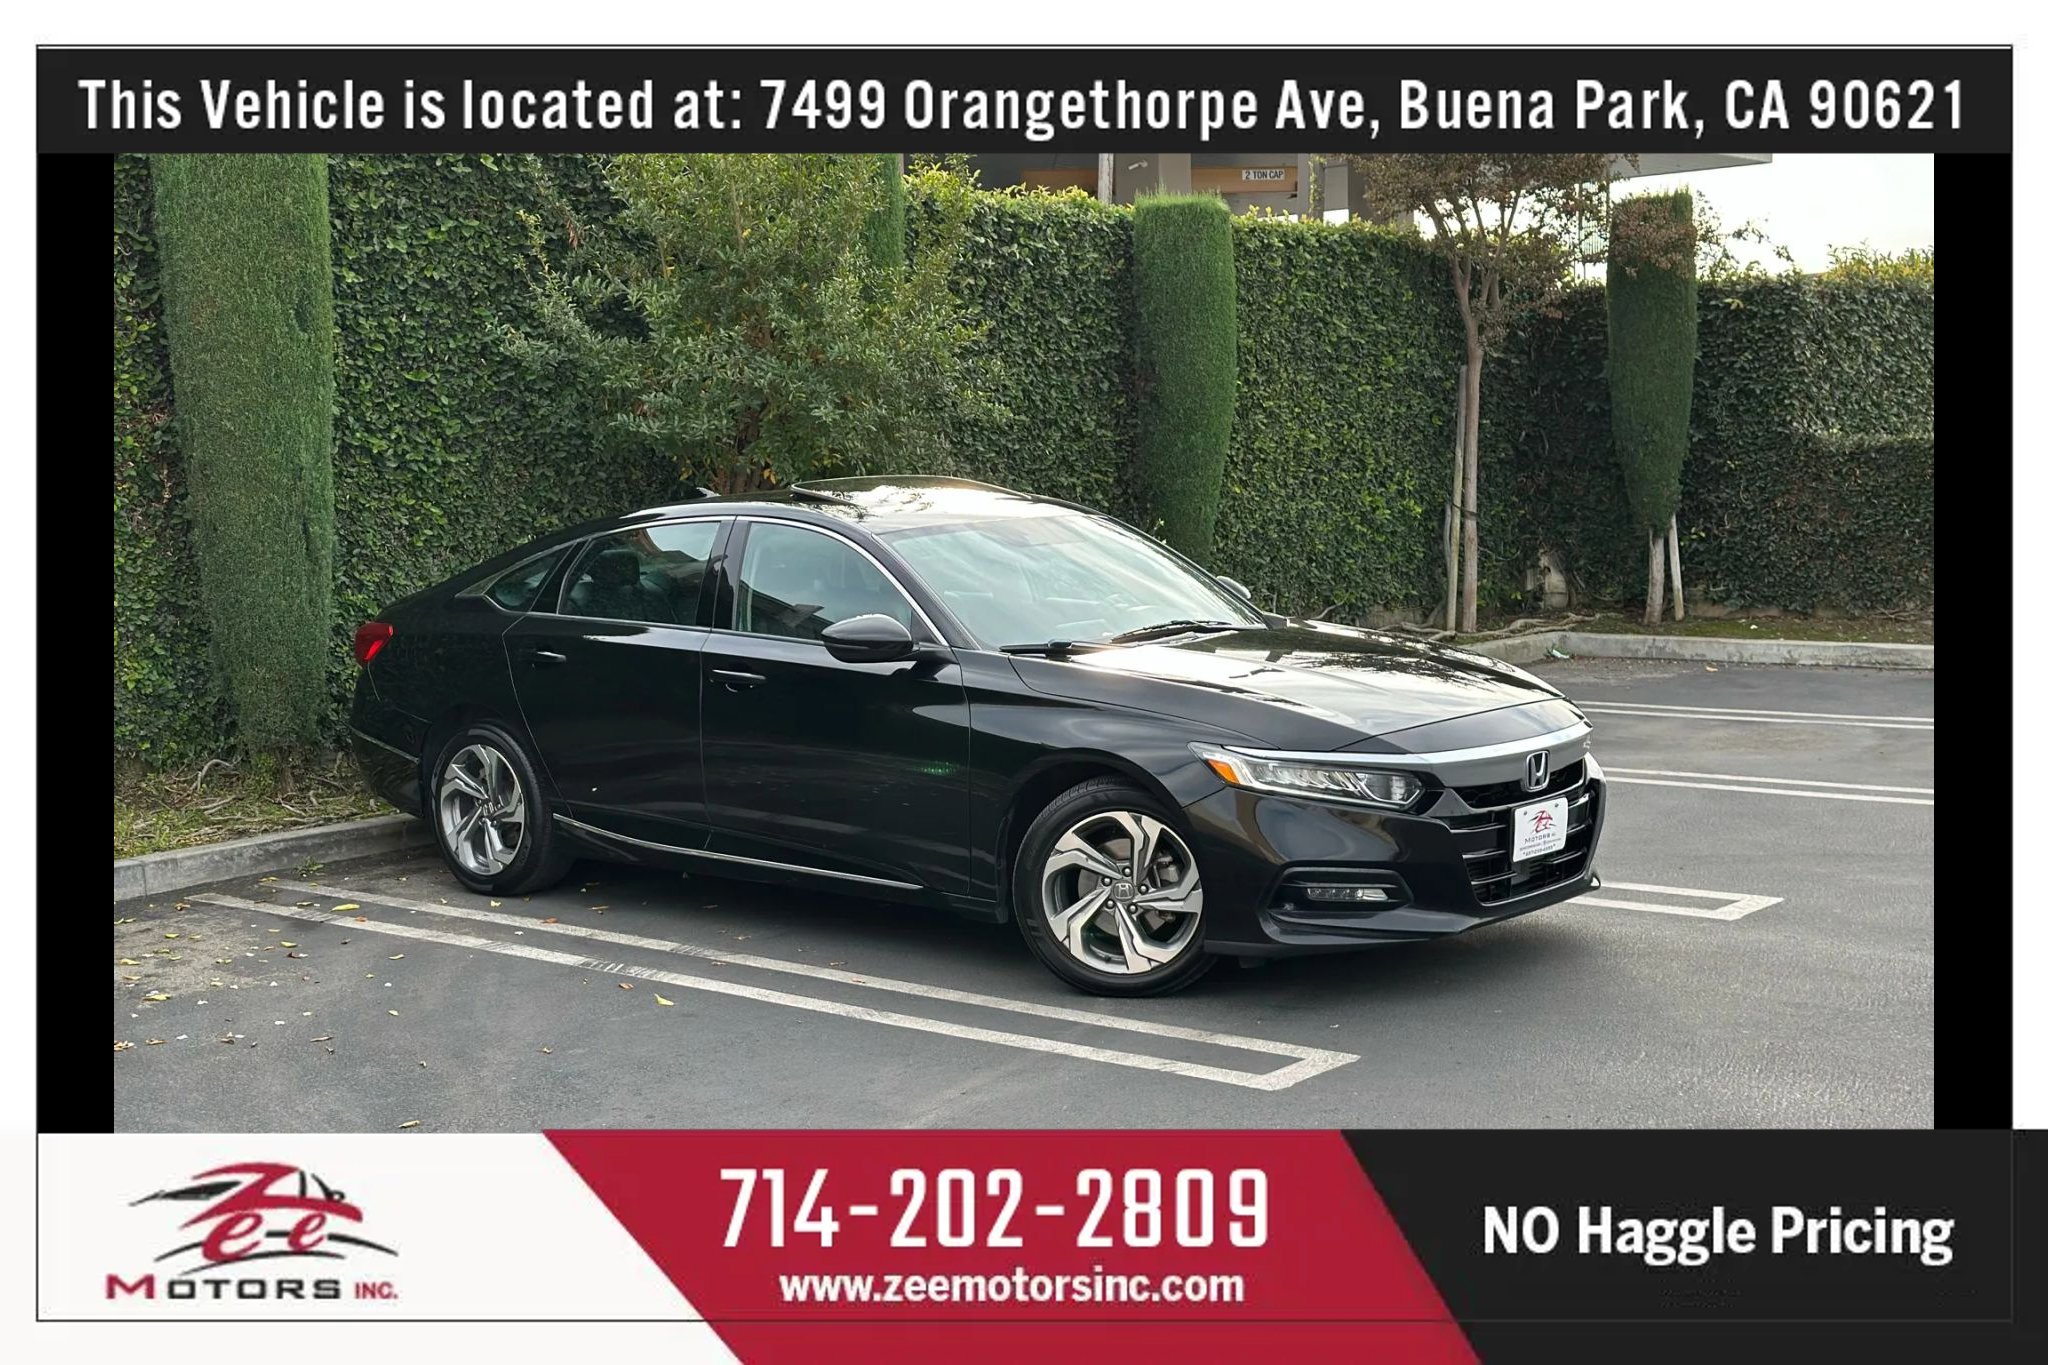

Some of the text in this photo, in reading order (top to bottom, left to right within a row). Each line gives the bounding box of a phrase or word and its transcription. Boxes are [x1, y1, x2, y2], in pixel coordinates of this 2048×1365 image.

[1245, 170, 1283, 179] 2 TON CAP
